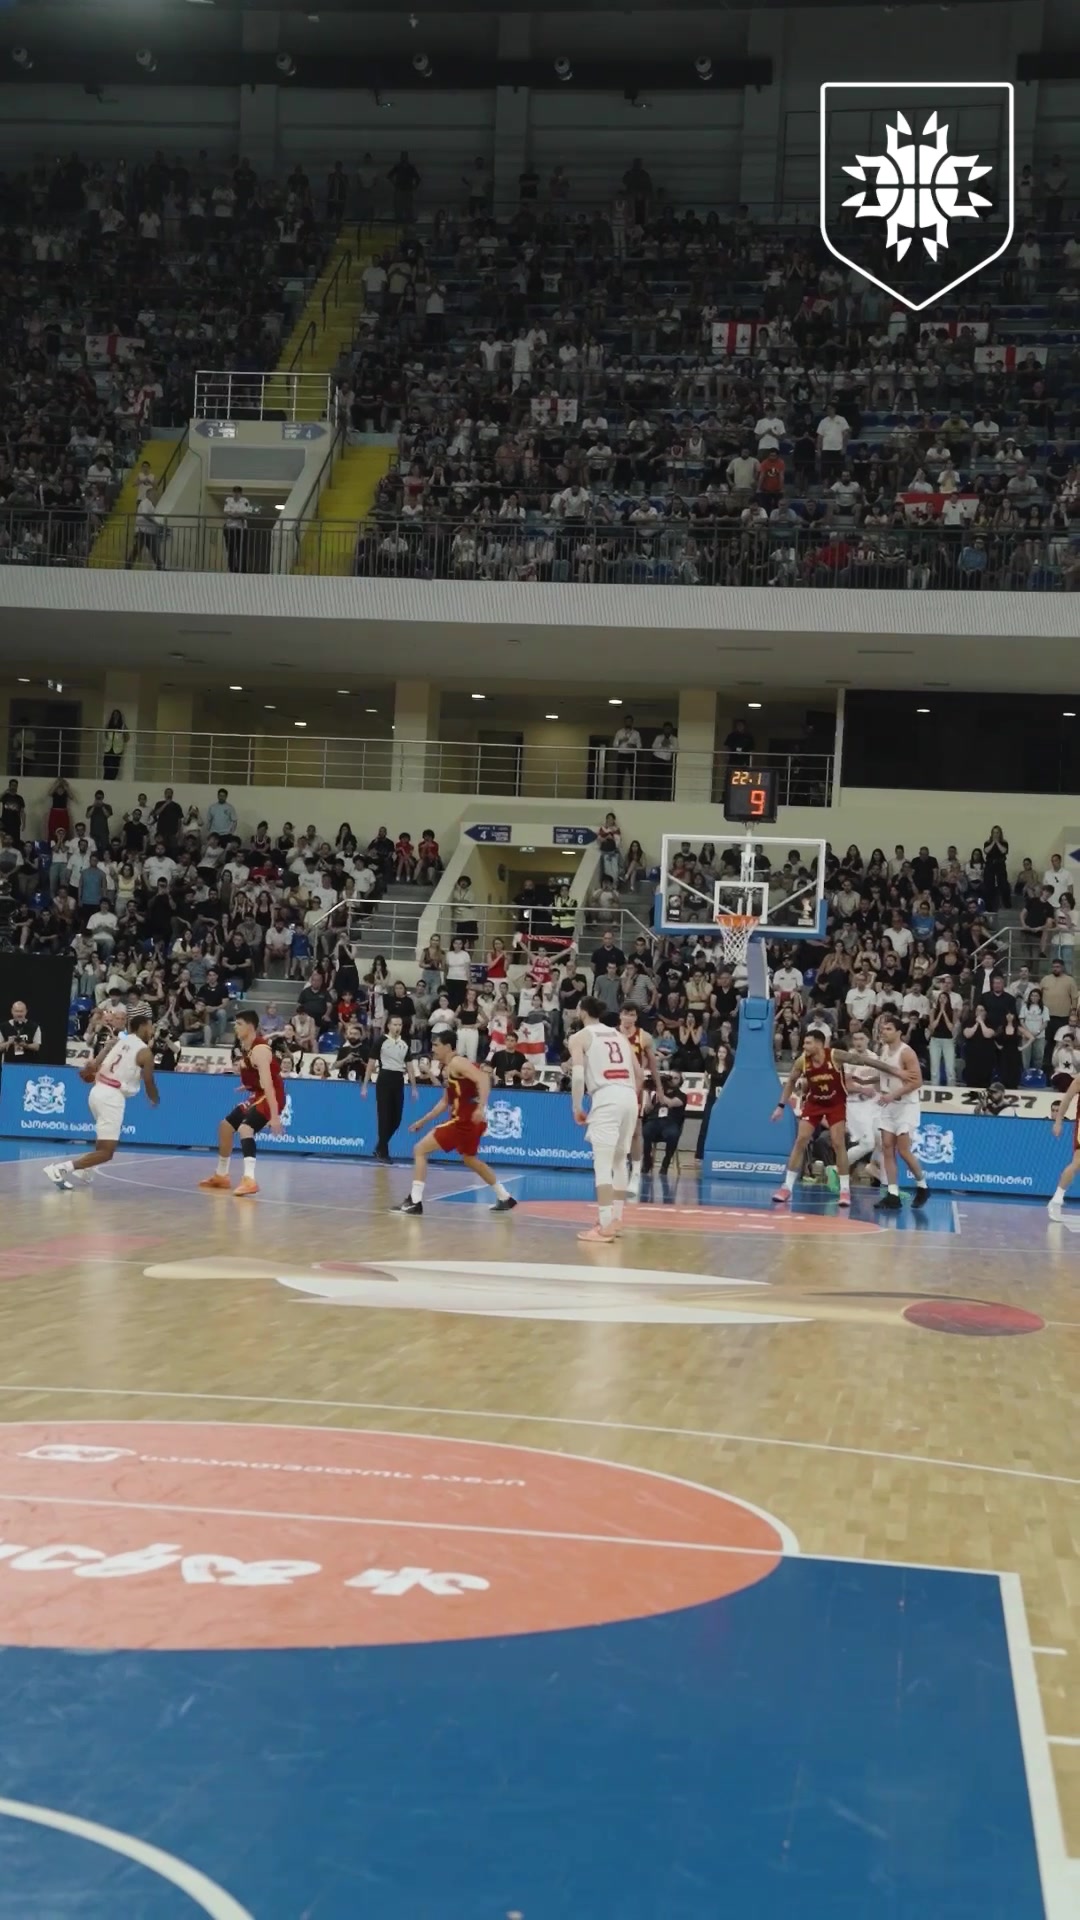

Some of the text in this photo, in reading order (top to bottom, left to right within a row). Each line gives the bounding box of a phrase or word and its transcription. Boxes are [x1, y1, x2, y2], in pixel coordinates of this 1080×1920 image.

[750, 789, 766, 815] 9
[480, 830, 487, 840] 4
[577, 834, 584, 844] 6
[918, 1089, 1038, 1109] UP 227
